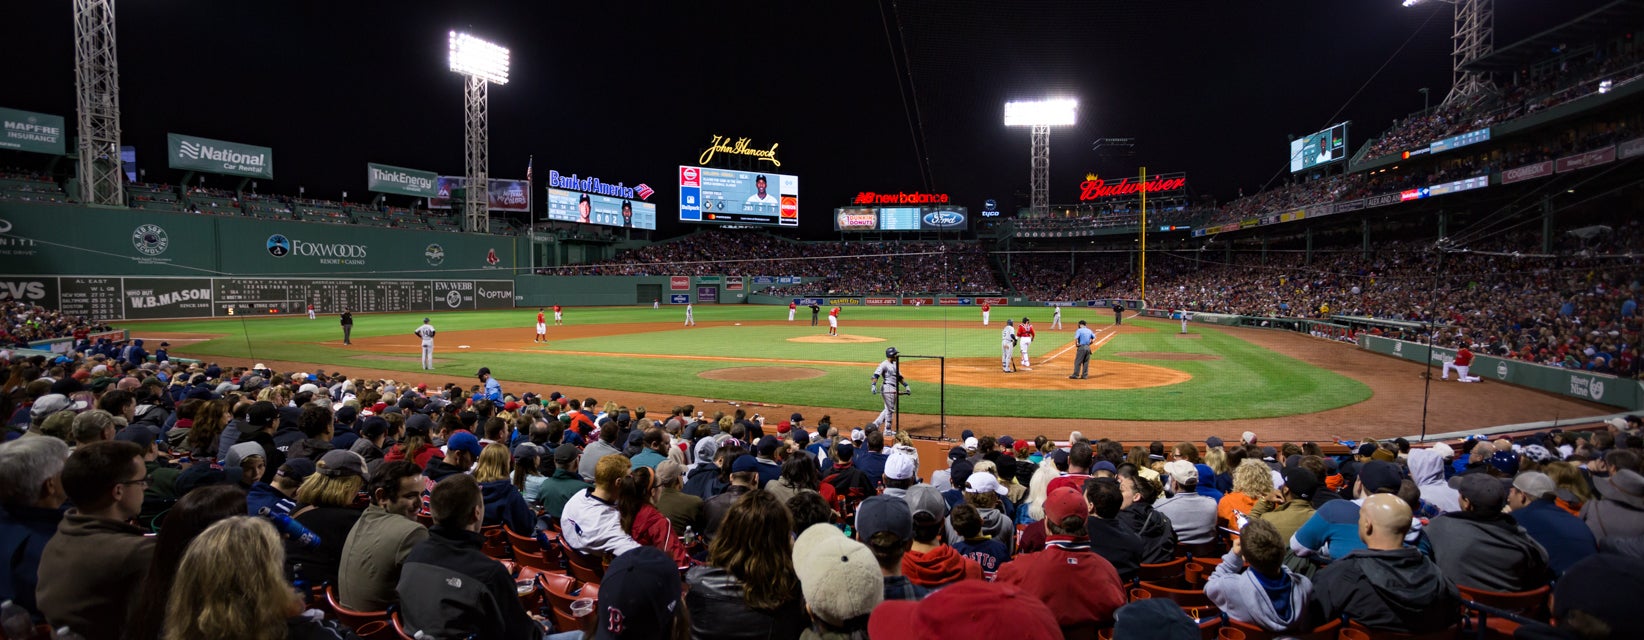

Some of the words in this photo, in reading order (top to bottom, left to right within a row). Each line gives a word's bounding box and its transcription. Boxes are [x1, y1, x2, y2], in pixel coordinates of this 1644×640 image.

[4, 120, 60, 135] MAPFRE
[7, 131, 57, 143] INSURANCE
[200, 145, 265, 165] National
[699, 135, 733, 165] John
[733, 137, 781, 167] Hancock
[238, 165, 262, 173] Rental
[372, 168, 432, 189] ThinkEnergy
[549, 169, 580, 189] Bank
[580, 177, 593, 192] of
[593, 178, 633, 199] America
[1080, 175, 1186, 201] Budweiser
[876, 194, 899, 204] new
[900, 192, 949, 204] balance
[612, 216, 617, 224] 2
[931, 213, 956, 224] Ford
[293, 240, 366, 258] FOXWOODS
[0, 282, 46, 300] CVS
[451, 282, 472, 290] WEBB
[486, 291, 512, 299] OPTUM
[1570, 384, 1588, 396] Nine
[607, 606, 626, 633] B
